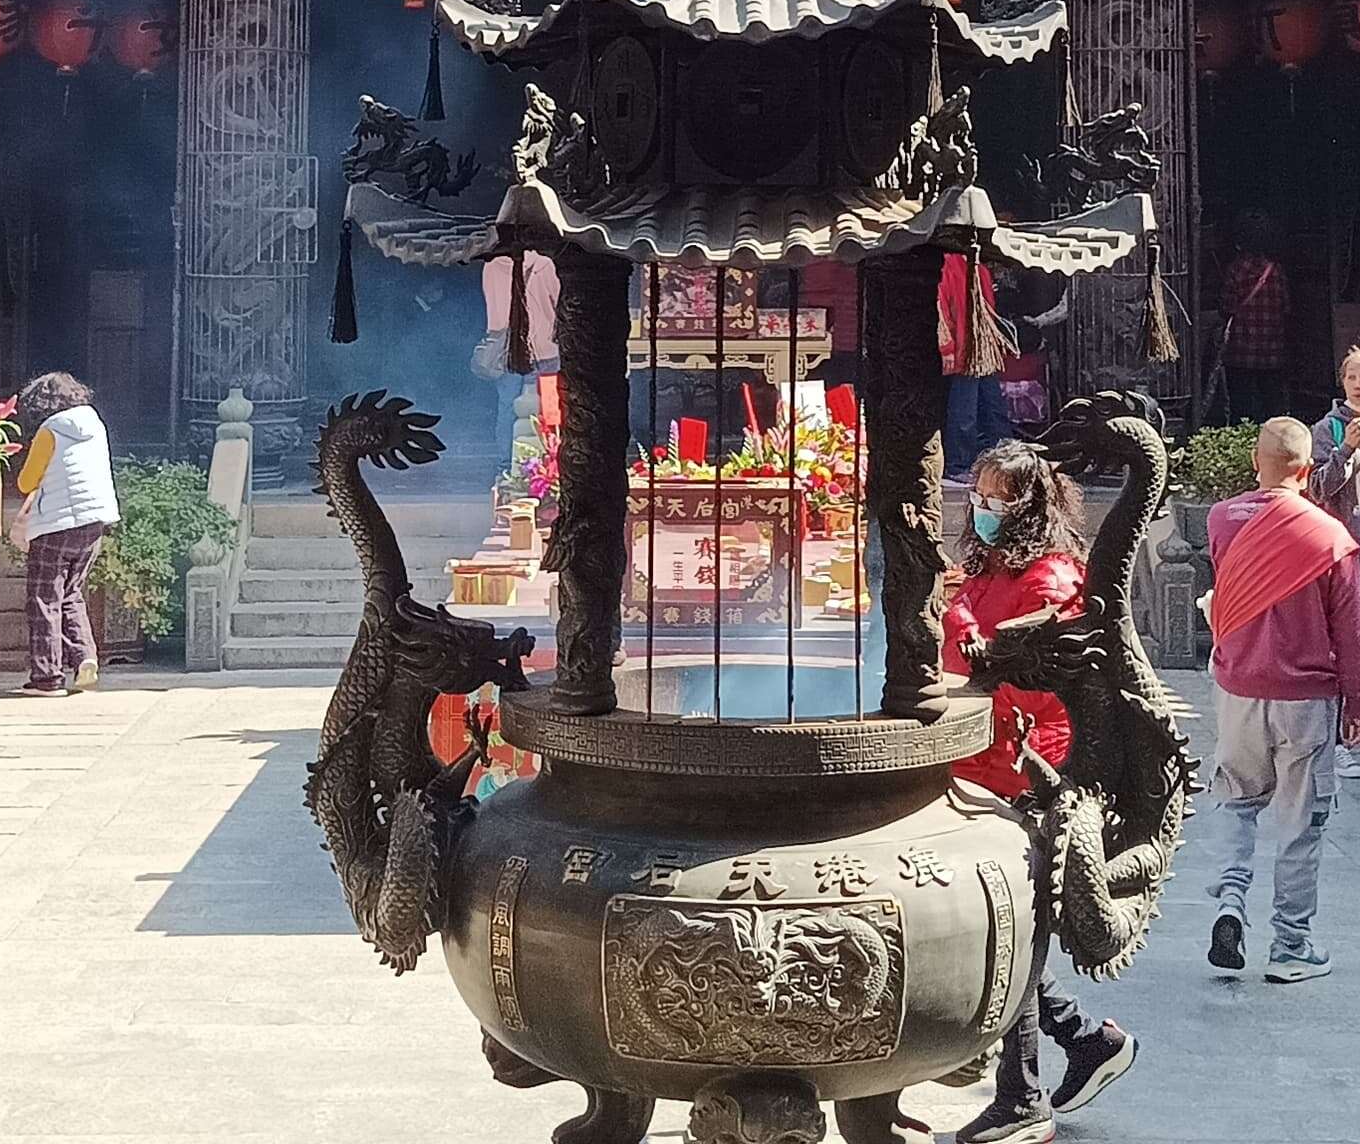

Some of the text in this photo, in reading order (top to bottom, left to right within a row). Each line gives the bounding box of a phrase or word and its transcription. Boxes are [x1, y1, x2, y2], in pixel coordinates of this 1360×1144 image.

[666, 497, 740, 519] 天后宮
[663, 606, 744, 625] 賽錢箱
[562, 844, 956, 899] 鹿港天后宮
